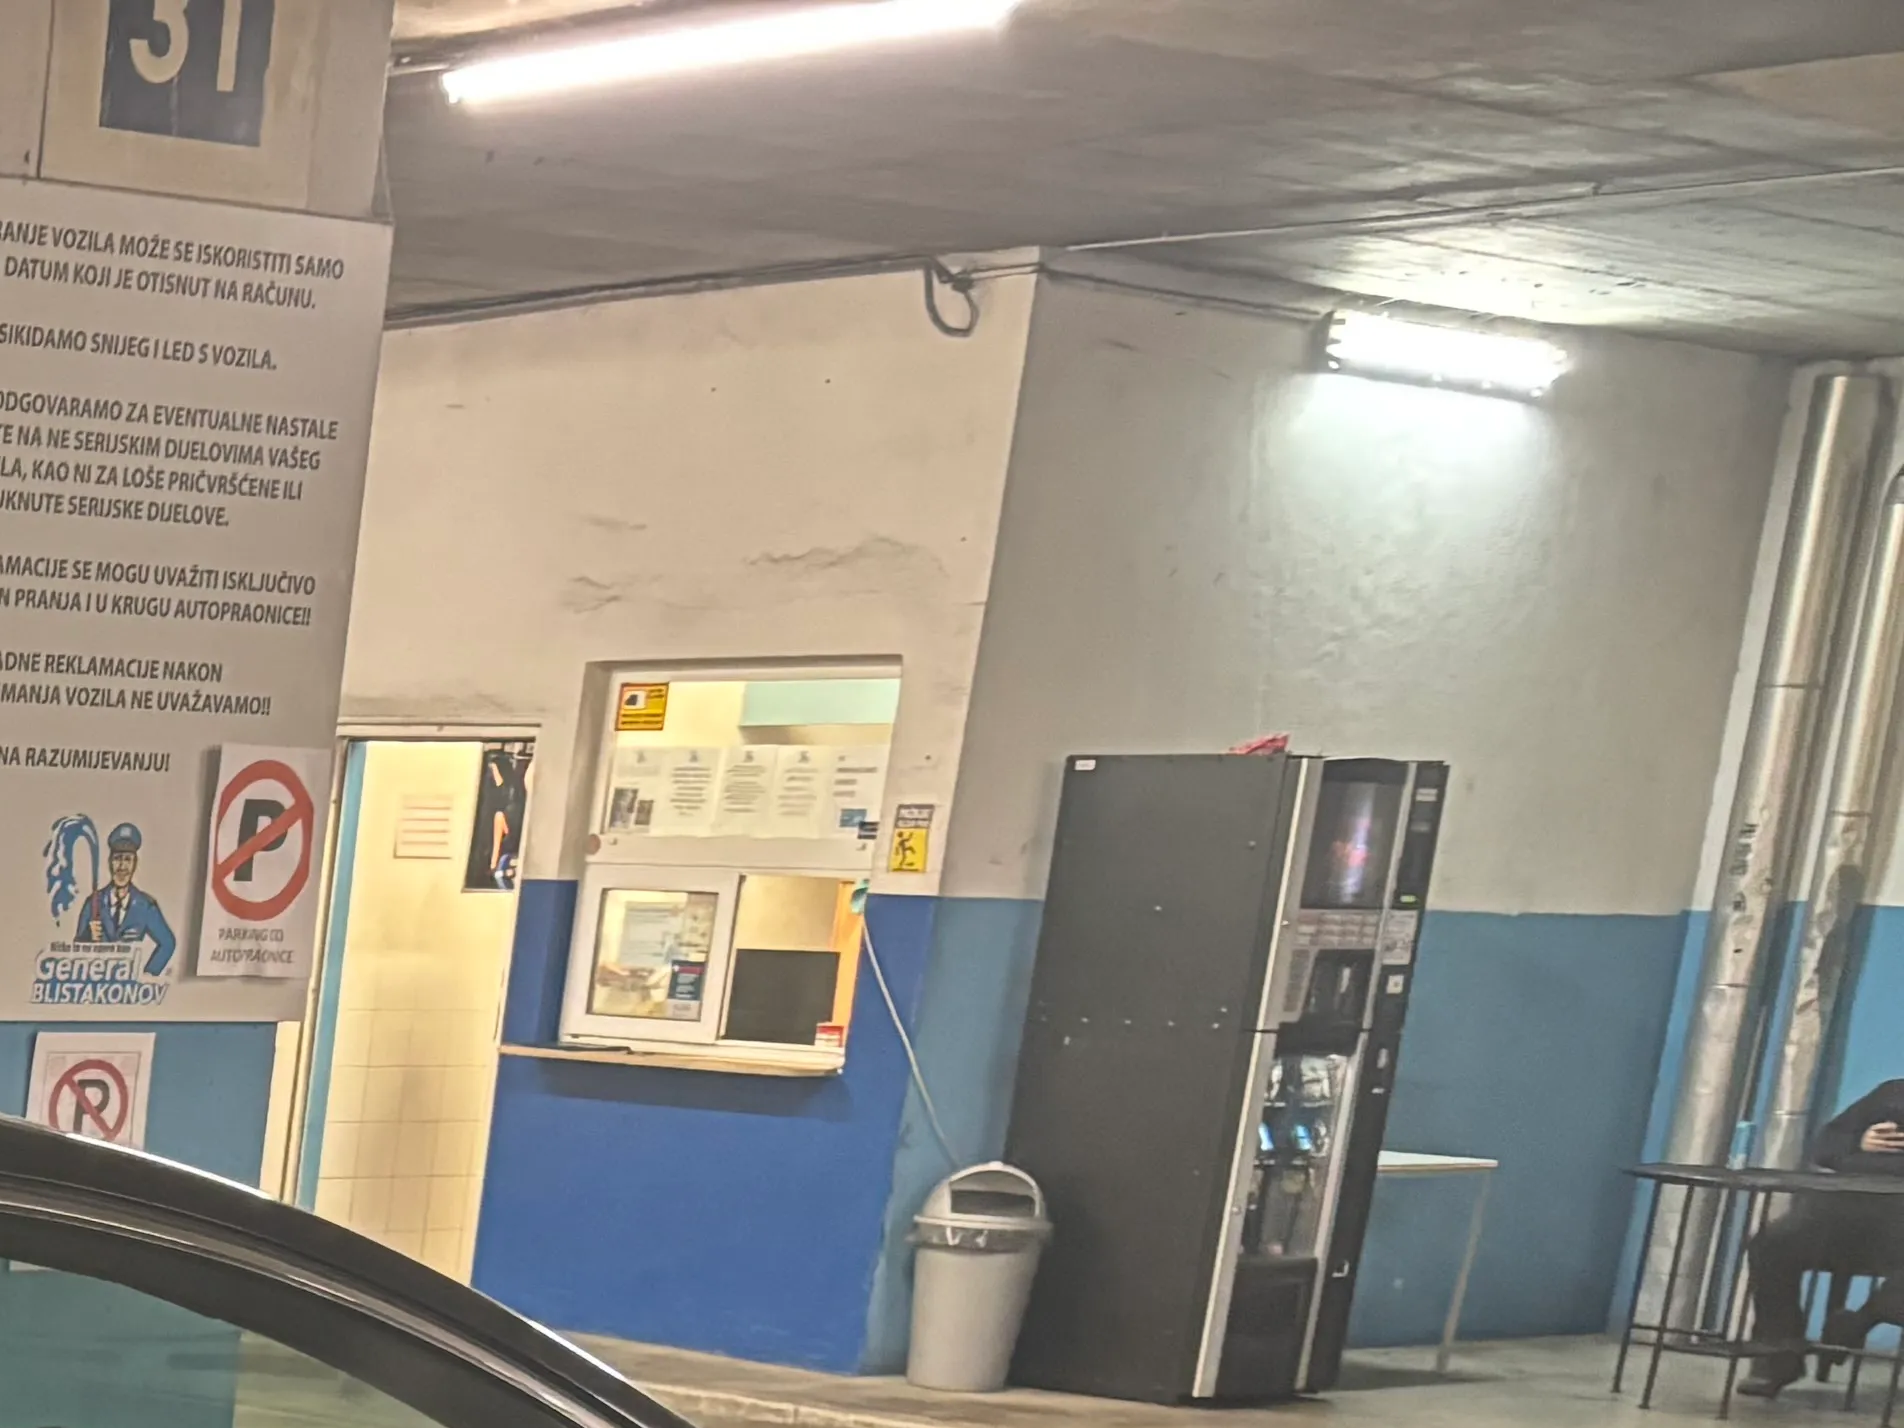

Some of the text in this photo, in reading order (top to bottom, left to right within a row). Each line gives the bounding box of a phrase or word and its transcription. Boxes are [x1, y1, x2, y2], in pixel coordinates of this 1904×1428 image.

[52, 227, 114, 254] VOZILA
[119, 235, 170, 259] MOŽE
[174, 241, 193, 262] SE
[196, 244, 291, 274] ISKORISTITI
[295, 256, 343, 279] SAMO
[5, 256, 68, 283] DATUM
[73, 263, 111, 287] KOJI
[114, 269, 133, 289] JE
[137, 271, 211, 298] OTISNUT
[214, 279, 237, 300] NA
[243, 282, 315, 308] RAČUNU.
[91, 333, 149, 357] SNIJEG
[154, 339, 159, 358] I
[163, 341, 194, 361] LED
[199, 344, 208, 364] S
[213, 345, 276, 370] VOZILA.
[126, 403, 148, 423] ZA
[153, 405, 262, 433] EVENTUALNE
[267, 415, 338, 440] NASTALE
[18, 426, 41, 447] NA
[47, 428, 70, 448] NE
[74, 431, 160, 456] SERIJSKIM
[165, 439, 263, 465] DIJELOVIMA
[269, 446, 320, 470] VAŠEG
[32, 460, 69, 482] KAO
[74, 463, 91, 483] NI
[95, 465, 117, 486] ZA
[123, 466, 164, 489] LOŠE
[283, 481, 302, 500] ILI
[68, 496, 143, 519] SERIJSKE
[147, 502, 229, 526] DIJELOVE.
[72, 560, 92, 580] SE
[95, 562, 149, 584] MOGU
[154, 565, 219, 589] UVAŽITI
[223, 571, 315, 595] ISKLJUČIVO
[15, 589, 81, 611] PRANJA
[86, 593, 91, 612] I
[96, 594, 107, 613] U
[112, 594, 171, 617] KRUGU
[174, 600, 311, 626] AUTOPRAONICE!!
[44, 654, 159, 678] REKLAMACIJE
[163, 661, 222, 682] NAKON
[66, 687, 125, 708] VOZILA
[131, 691, 153, 709] NE
[157, 690, 270, 716] UVAŽAVAMO!!
[26, 748, 170, 772] RAZUMIJEVANJU!
[36, 949, 141, 982] General
[31, 981, 169, 1005] BLISTAKONOV
